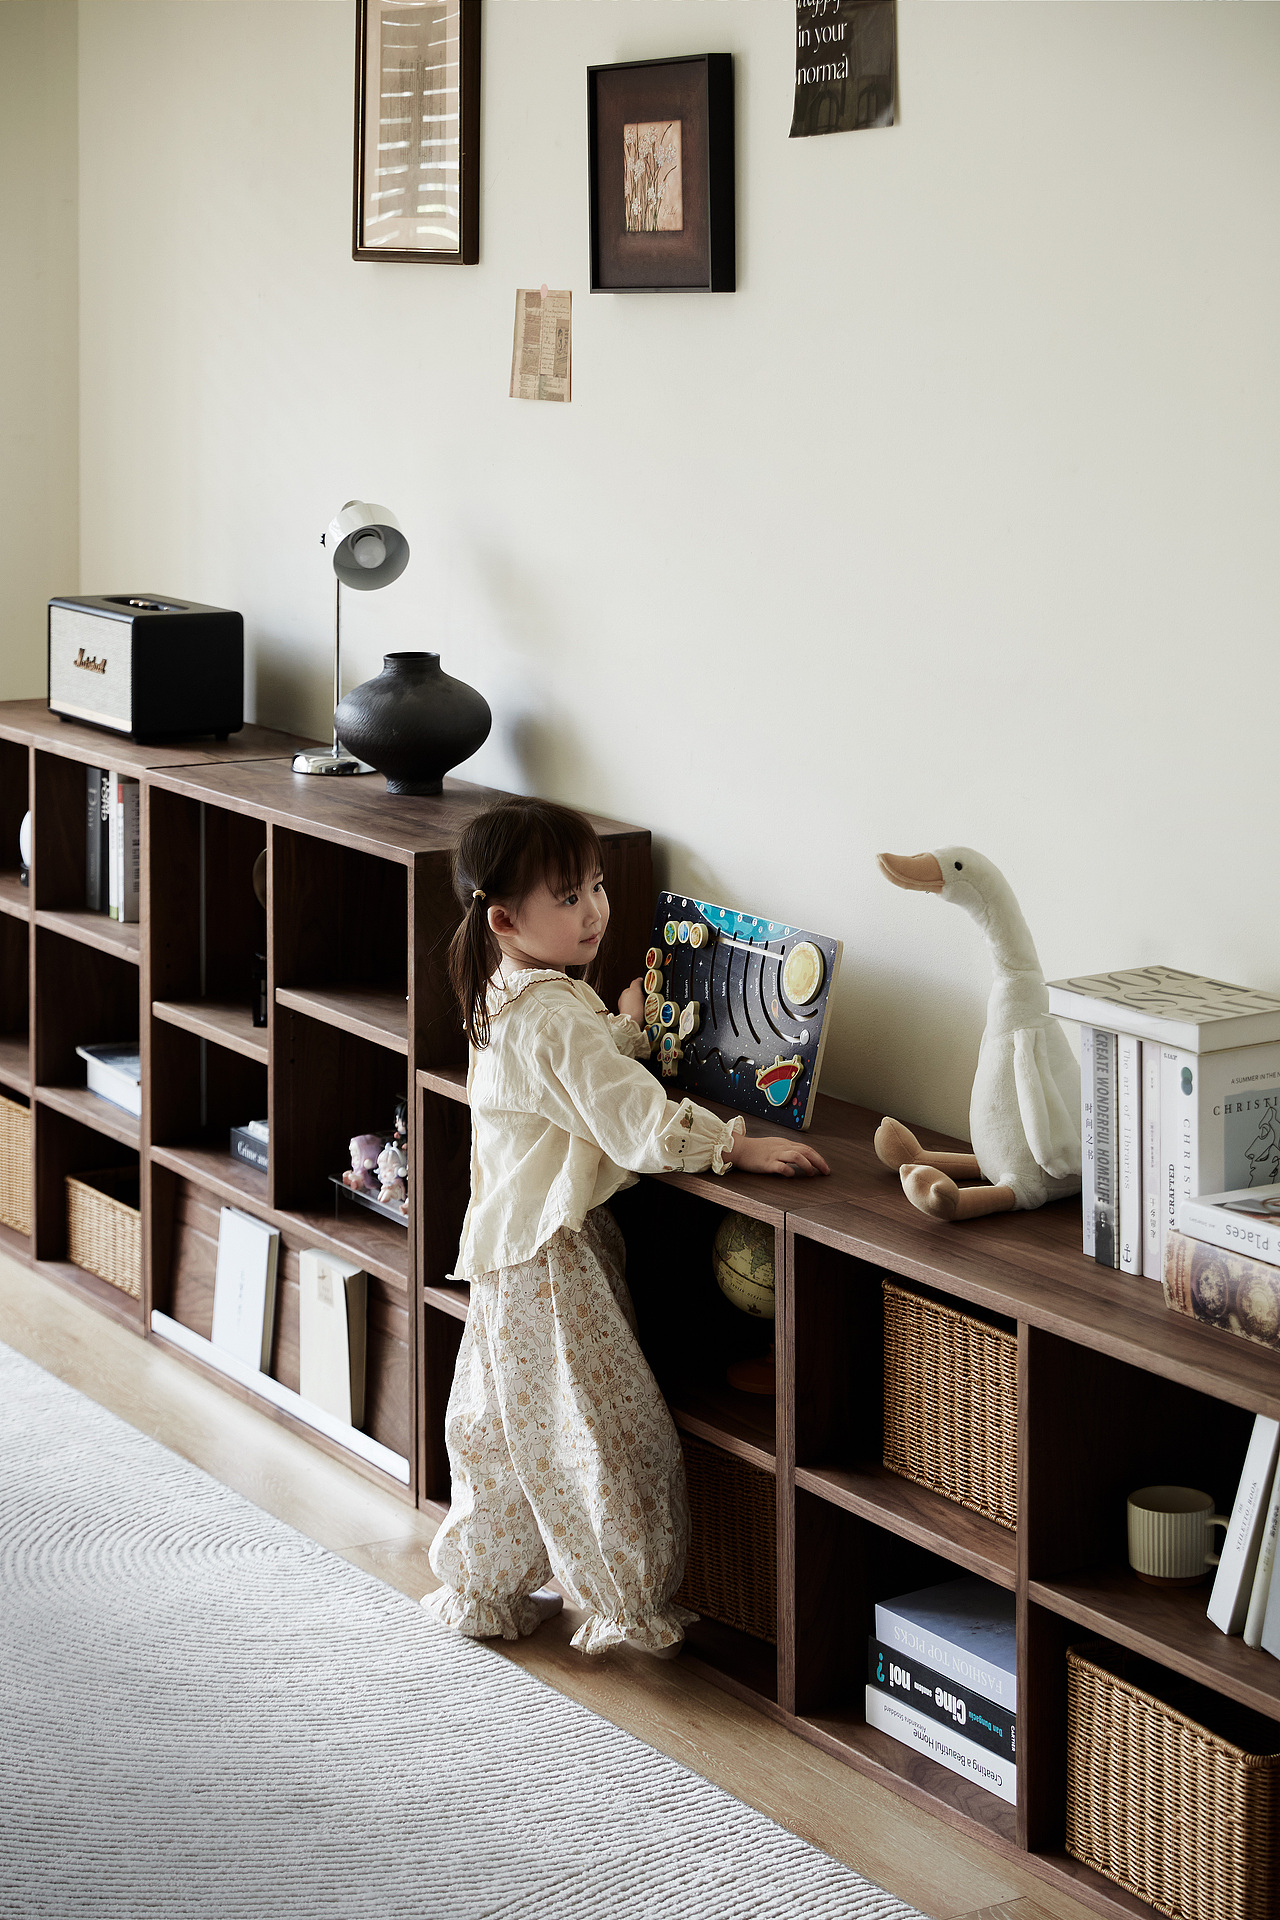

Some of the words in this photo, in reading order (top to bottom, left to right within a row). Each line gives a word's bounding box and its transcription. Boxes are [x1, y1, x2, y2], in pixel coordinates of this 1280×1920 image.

[798, 25, 810, 47] in
[813, 22, 848, 53] your
[797, 53, 849, 85] normal
[1095, 1033, 1109, 1074] CREATE
[1123, 1049, 1131, 1070] The
[1235, 1072, 1259, 1083] SUMMER
[1266, 1071, 1277, 1079] THE
[1096, 1077, 1109, 1145] WONDERFUL
[1123, 1104, 1131, 1120] of
[1124, 1127, 1132, 1190] libraries
[1097, 1148, 1110, 1205] HOMELIFE
[1168, 1218, 1175, 1226] &
[1225, 1224, 1269, 1251] Places
[1247, 1480, 1257, 1506] BOOK
[894, 1625, 925, 1654] PICKS
[927, 1645, 950, 1667] TOP
[889, 1662, 911, 1691] noi
[952, 1656, 1002, 1695] FASHION
[934, 1686, 967, 1725] Cine
[913, 1728, 934, 1749] Home
[935, 1740, 966, 1767] Beautiful
[966, 1758, 972, 1767] a
[972, 1758, 1003, 1787] Creating
